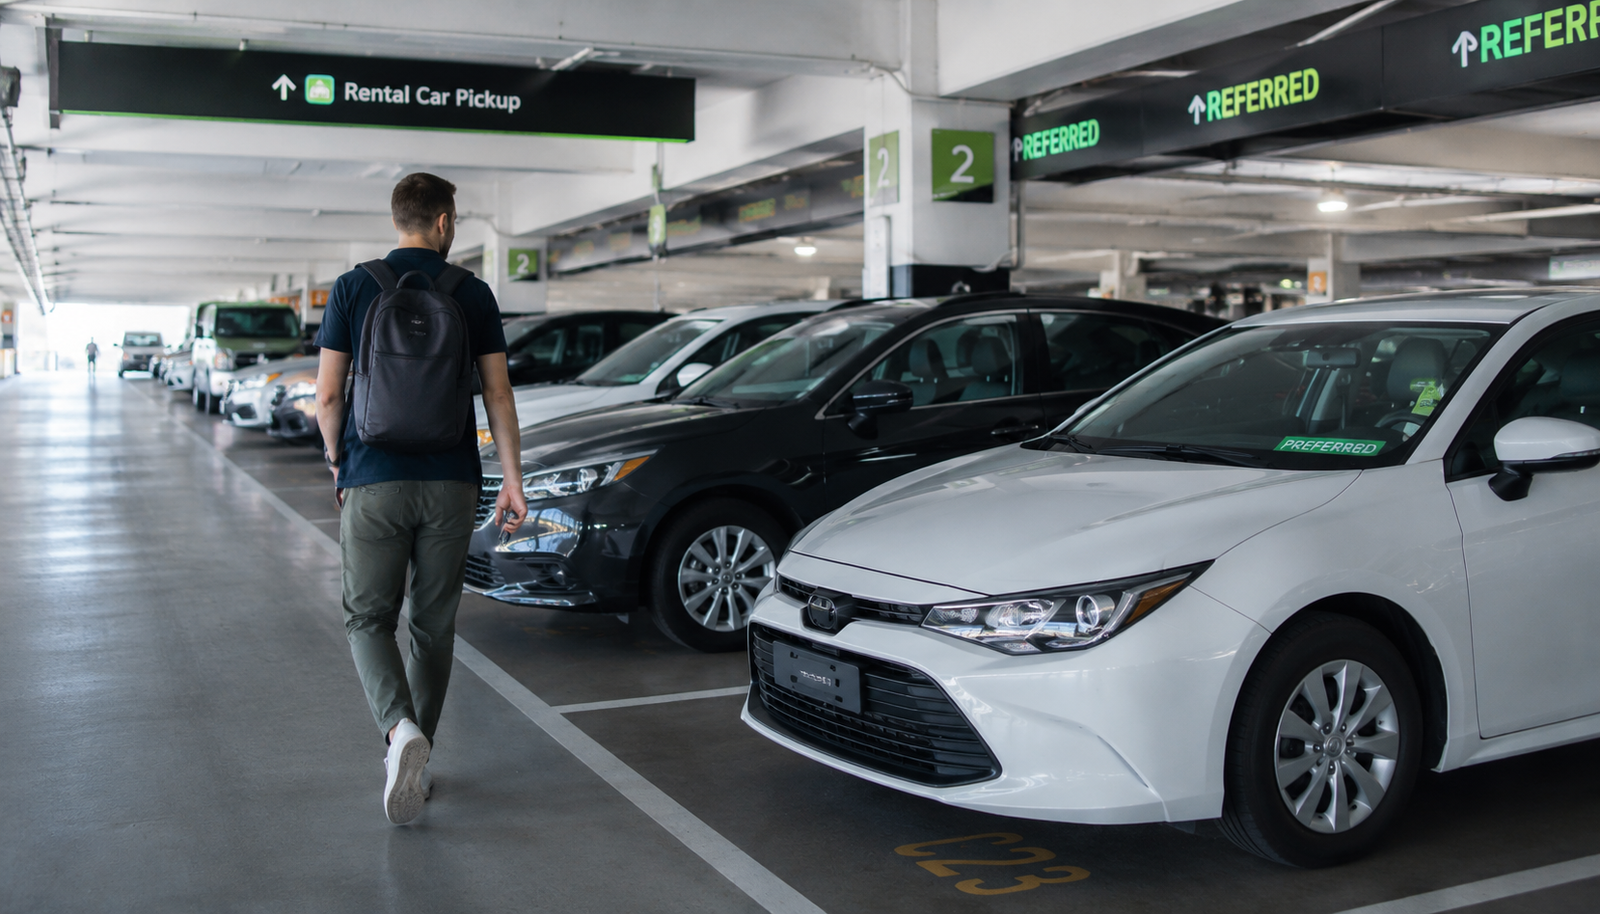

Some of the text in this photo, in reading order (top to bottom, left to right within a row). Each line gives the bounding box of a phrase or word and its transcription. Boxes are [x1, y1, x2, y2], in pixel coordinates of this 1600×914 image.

[344, 82, 521, 114] Rental Car Pickup
[1206, 67, 1320, 122] REFERRED
[877, 147, 890, 188] 2
[950, 144, 974, 184] 2
[516, 253, 530, 275] 2
[894, 832, 1091, 896] C23
